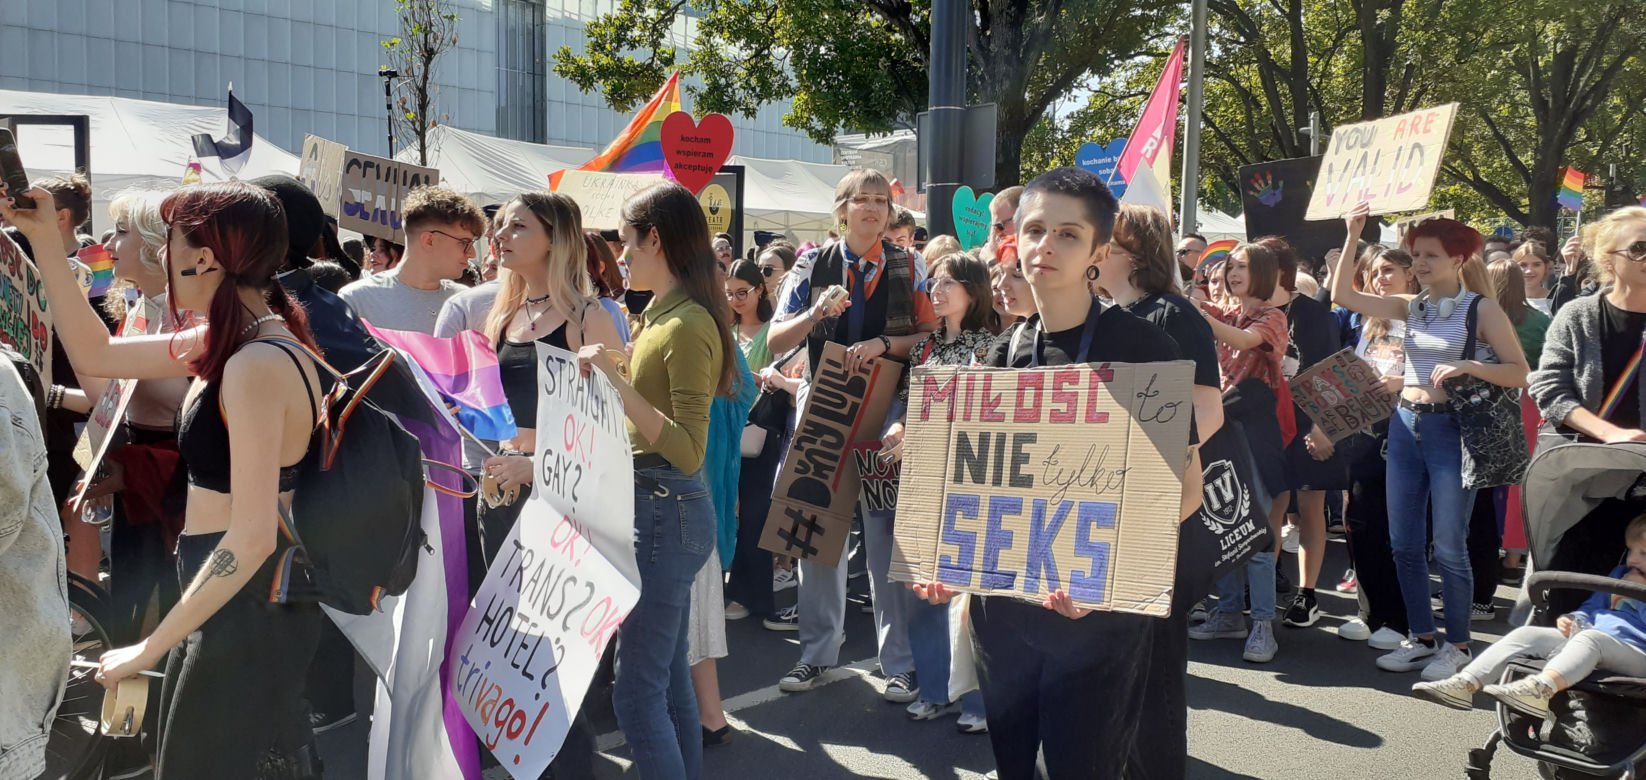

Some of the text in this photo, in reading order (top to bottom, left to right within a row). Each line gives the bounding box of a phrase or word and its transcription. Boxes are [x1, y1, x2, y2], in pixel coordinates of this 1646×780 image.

[676, 149, 714, 159] wspieram
[680, 134, 712, 144] kocham
[1082, 155, 1112, 166] kochanie
[1333, 111, 1441, 155] YOU ARE
[343, 158, 431, 231] SEXU
[1325, 142, 1425, 208] VALID
[1136, 372, 1183, 424] to
[564, 413, 595, 471] OK!
[953, 431, 1132, 506] NIE tylko
[542, 448, 583, 514] GAY?
[1204, 469, 1235, 512] IV
[935, 492, 1118, 604] SEKS
[1220, 519, 1256, 550] LICEUM
[500, 539, 596, 633] TRANS?
[475, 593, 567, 702] HOTEL?
[457, 643, 550, 765] trivago!
